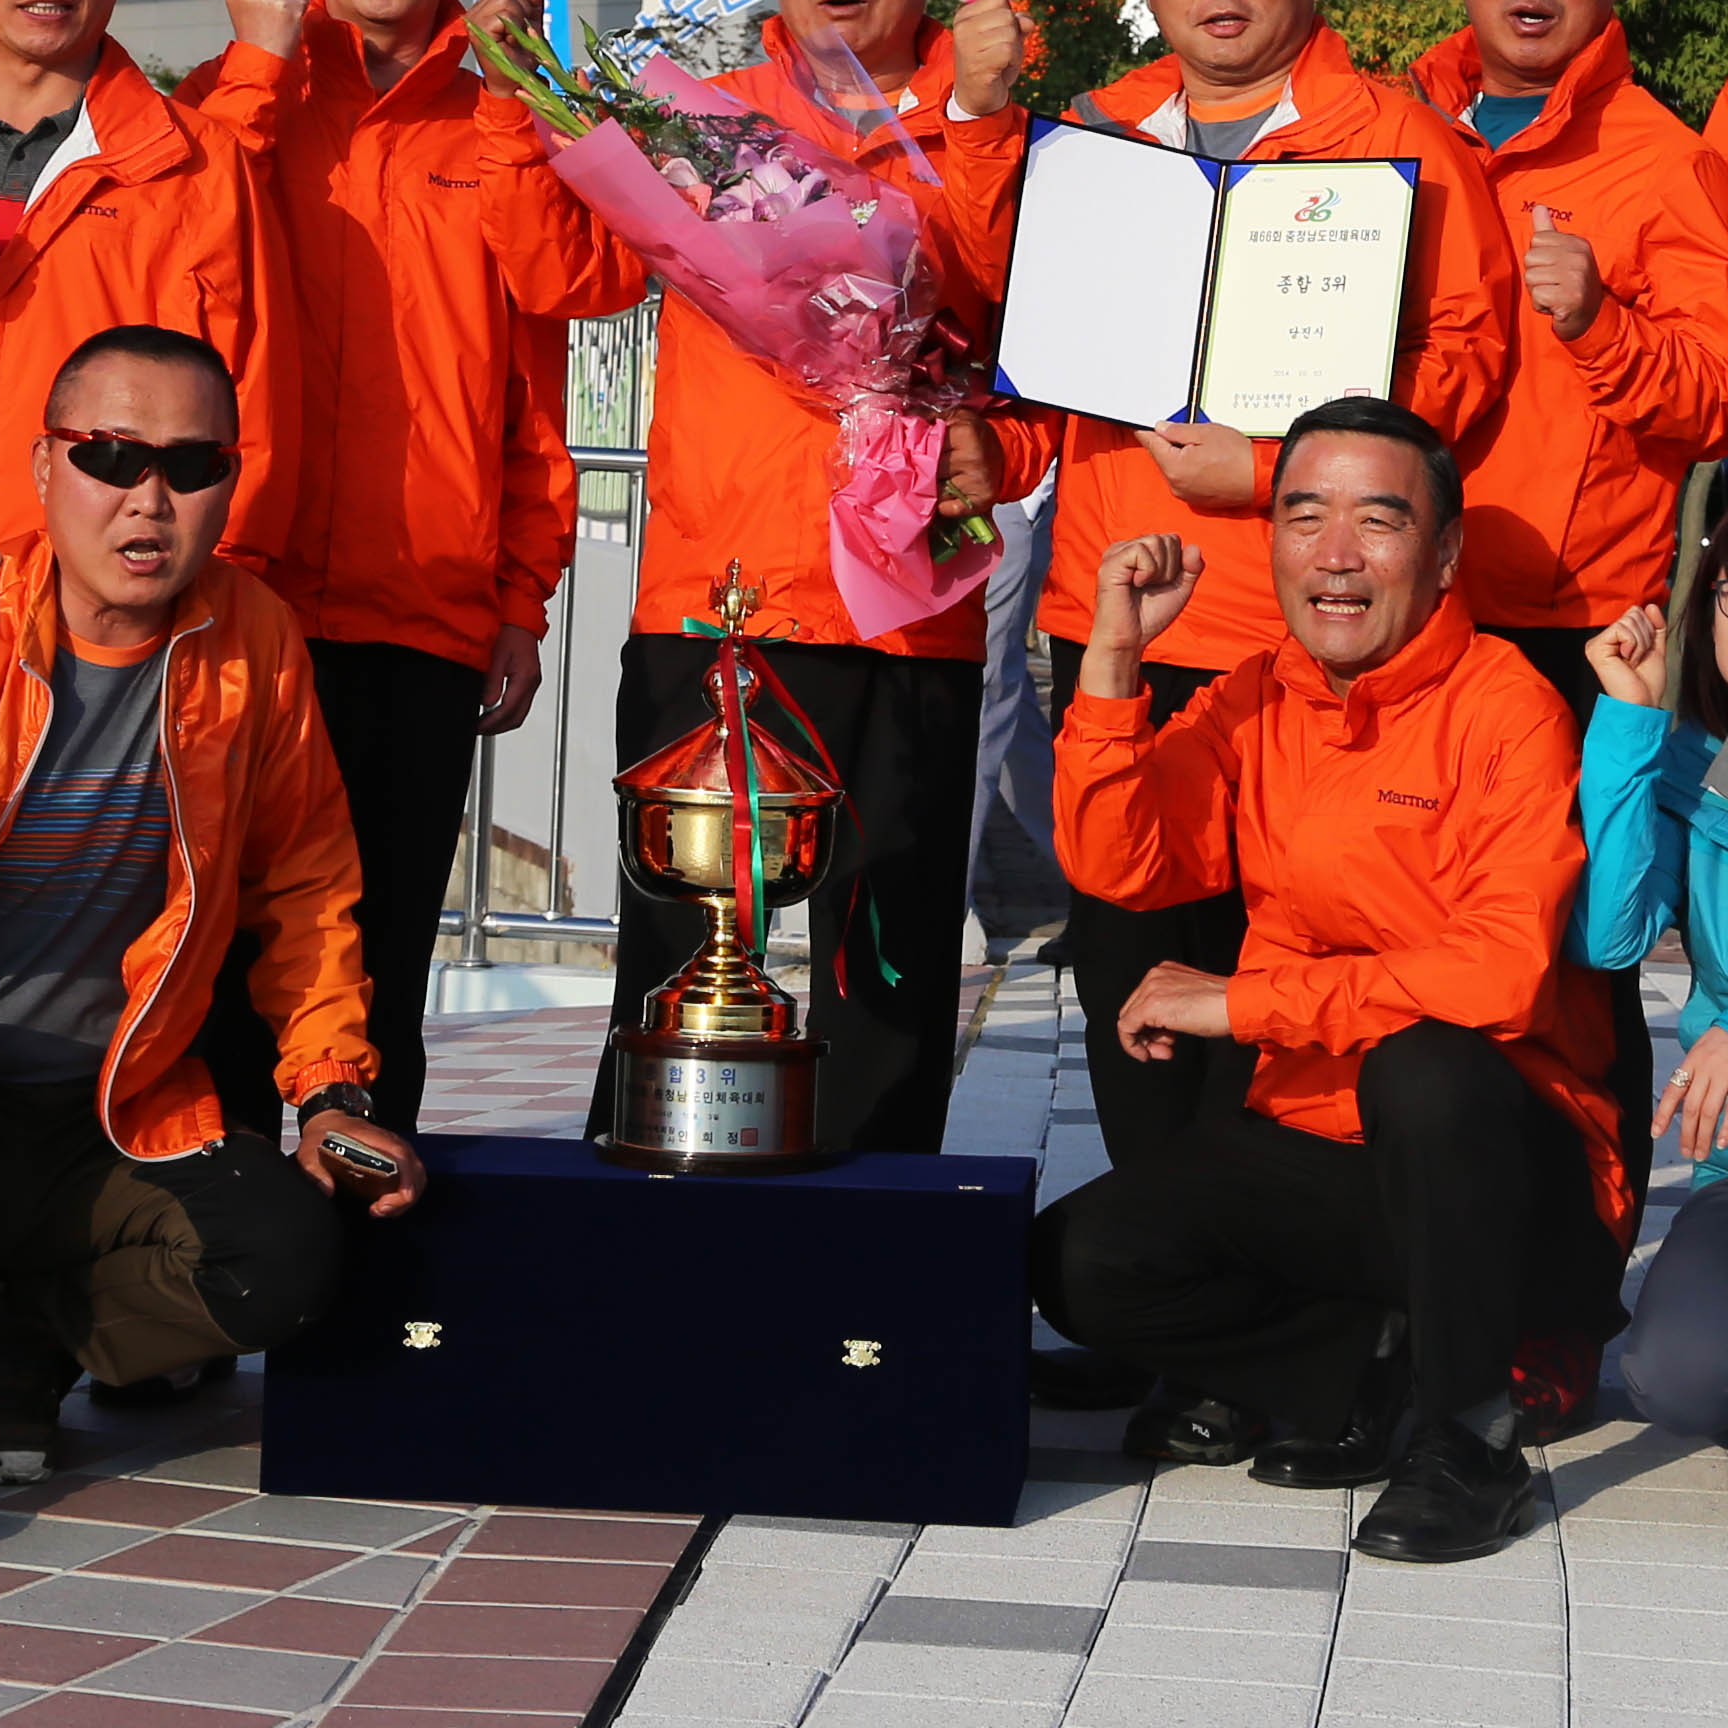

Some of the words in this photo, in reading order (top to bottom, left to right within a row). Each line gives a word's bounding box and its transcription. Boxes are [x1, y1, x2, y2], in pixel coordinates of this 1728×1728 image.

[1277, 274, 1312, 295] 종합
[1321, 274, 1347, 294] 3위
[1289, 326, 1325, 340] 당진시
[1377, 788, 1441, 813] Marmot
